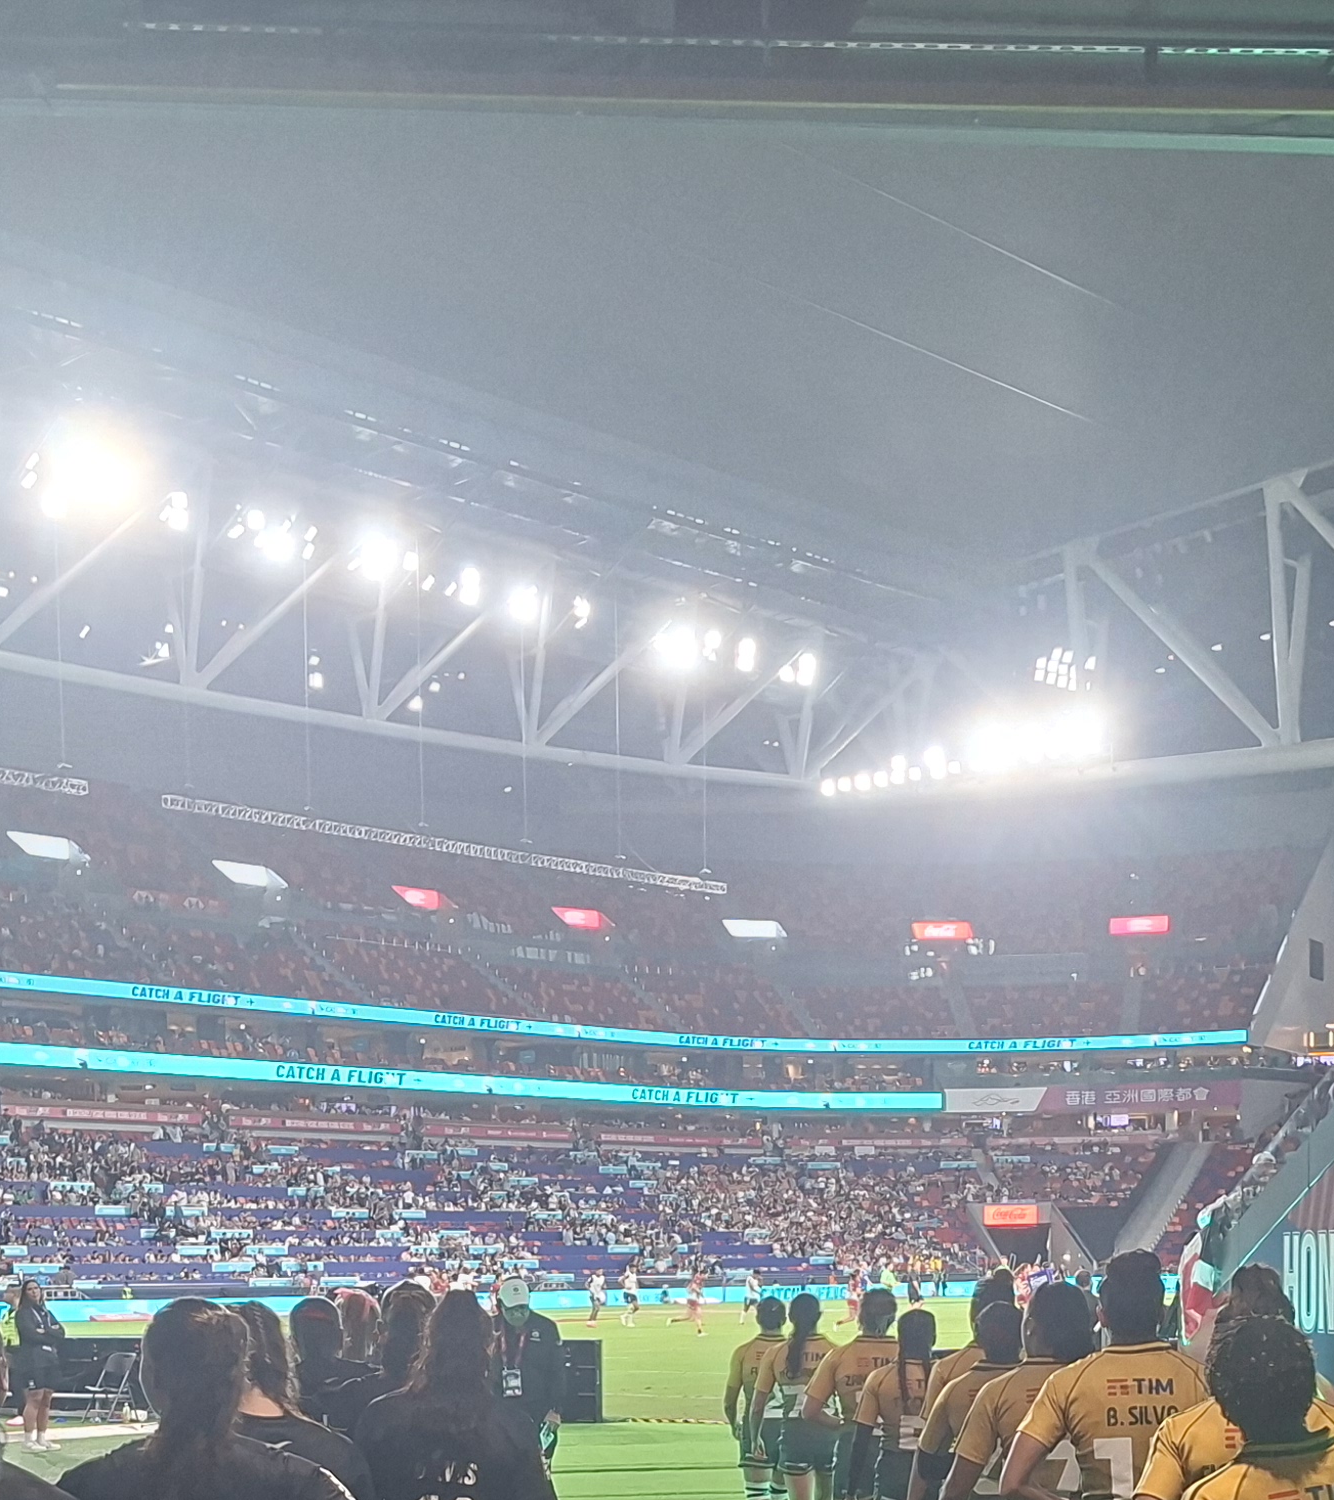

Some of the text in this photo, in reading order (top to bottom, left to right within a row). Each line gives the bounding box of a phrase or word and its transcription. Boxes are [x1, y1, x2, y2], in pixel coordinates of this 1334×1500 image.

[131, 986, 170, 1001] CATCH
[174, 989, 183, 1002] A
[434, 1013, 465, 1026] CATCH
[467, 1016, 476, 1028] A
[678, 1035, 708, 1047] CATCH
[968, 1039, 1005, 1051] CATCH
[276, 1064, 325, 1082] CATCH
[331, 1068, 341, 1083] A
[632, 1088, 670, 1102] CATCH
[672, 1090, 682, 1103] A
[1133, 1377, 1174, 1397] TIM
[1106, 1406, 1127, 1427] B.
